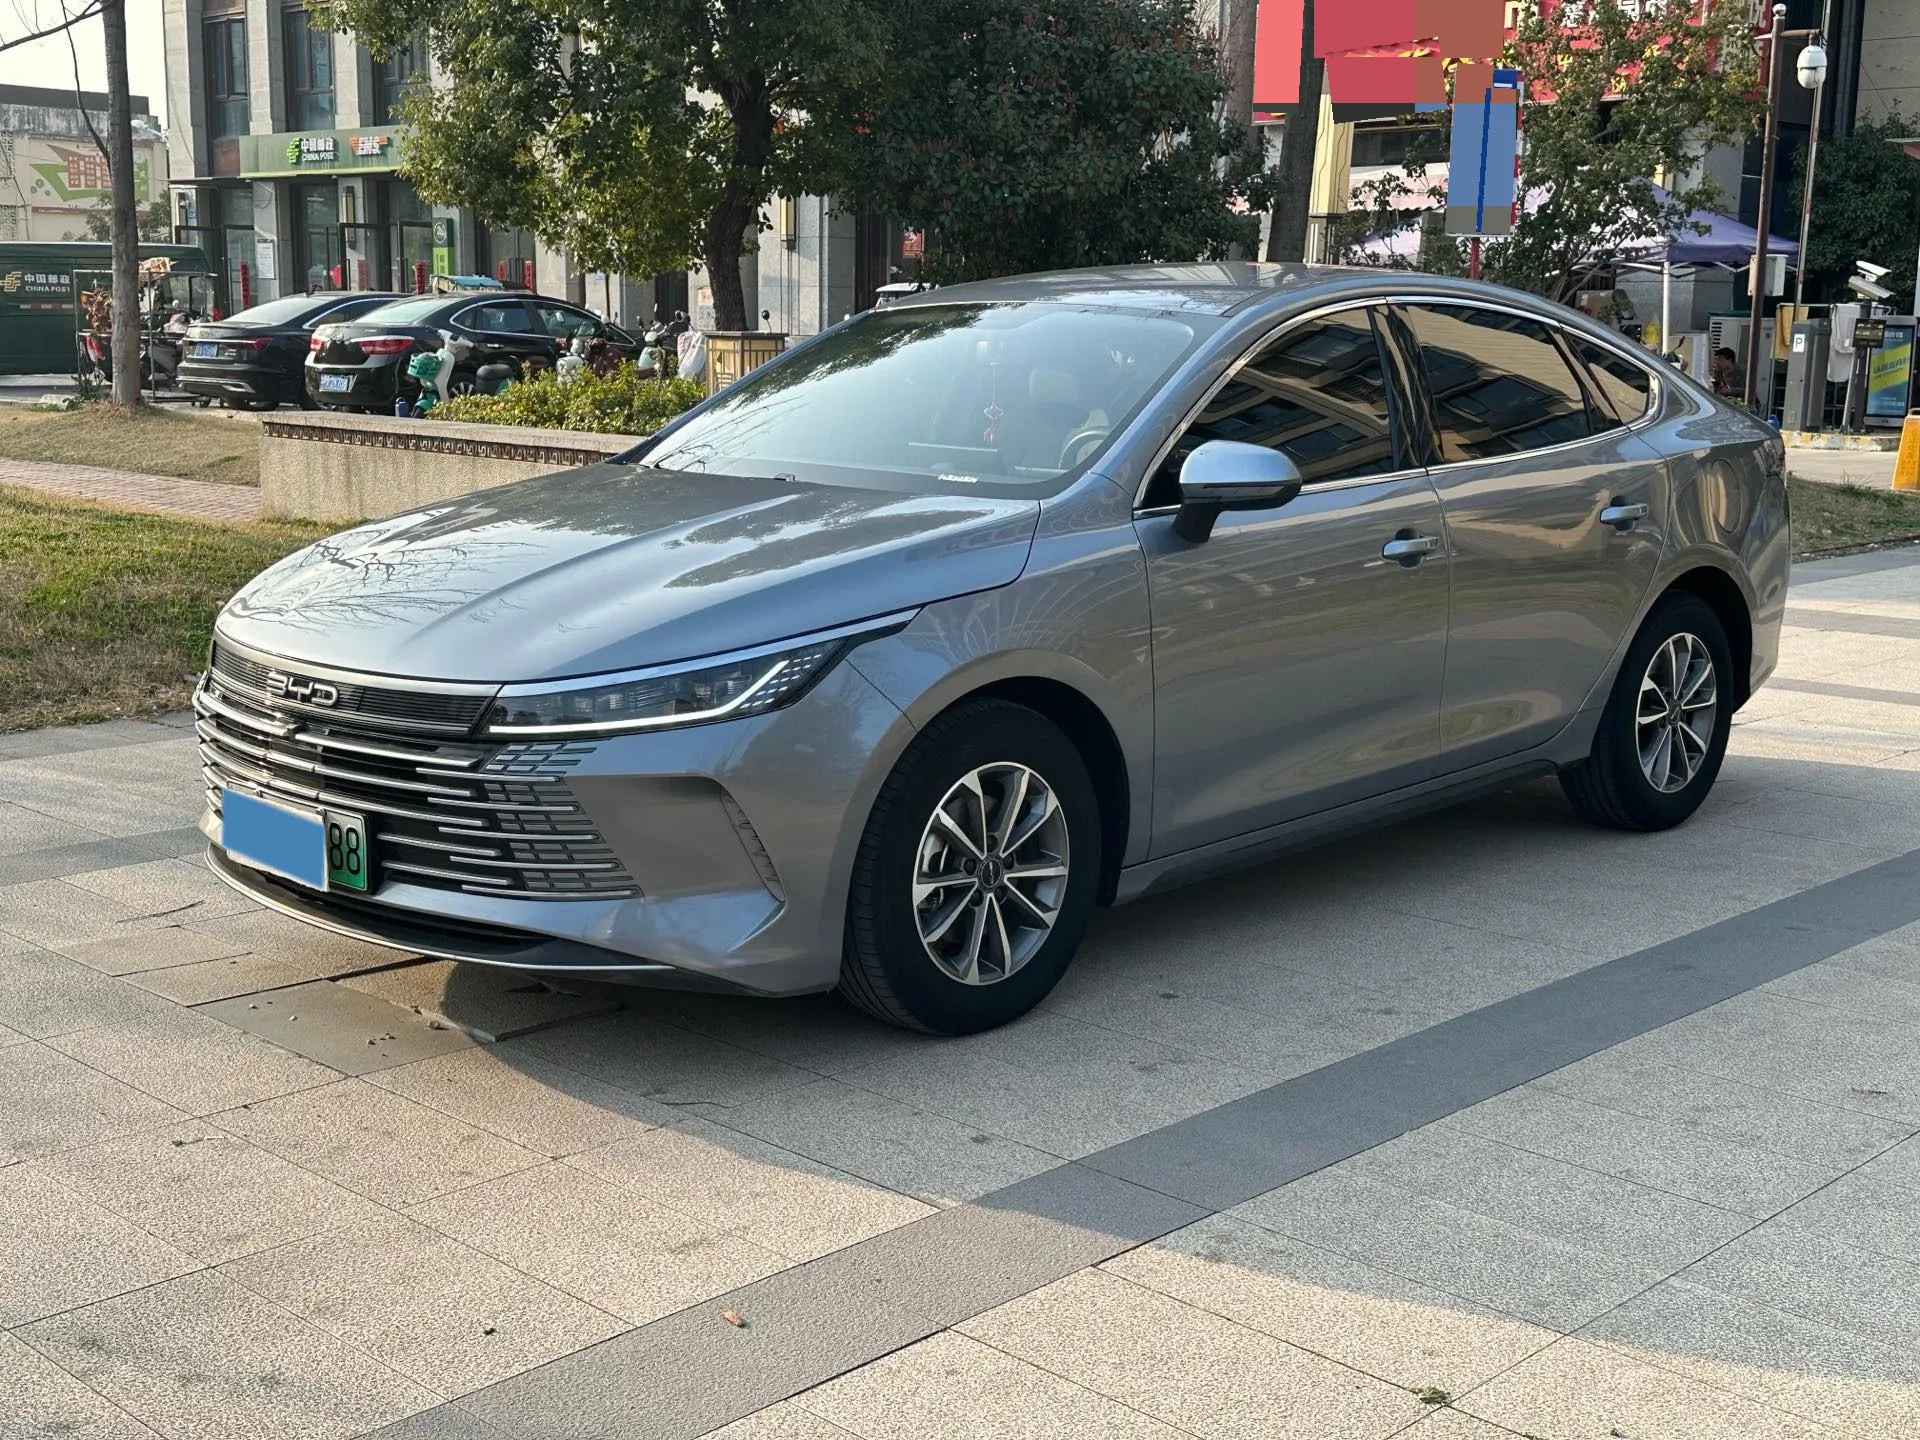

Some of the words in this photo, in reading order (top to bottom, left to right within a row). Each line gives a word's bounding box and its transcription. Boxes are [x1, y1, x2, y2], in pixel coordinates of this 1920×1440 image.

[301, 137, 334, 152] 中国邮政
[358, 137, 381, 155] EMS
[301, 153, 319, 161] CHINA
[320, 152, 334, 160] POST
[24, 273, 70, 284] 中国邮政
[1795, 337, 1803, 349] P
[266, 670, 338, 706] BYD
